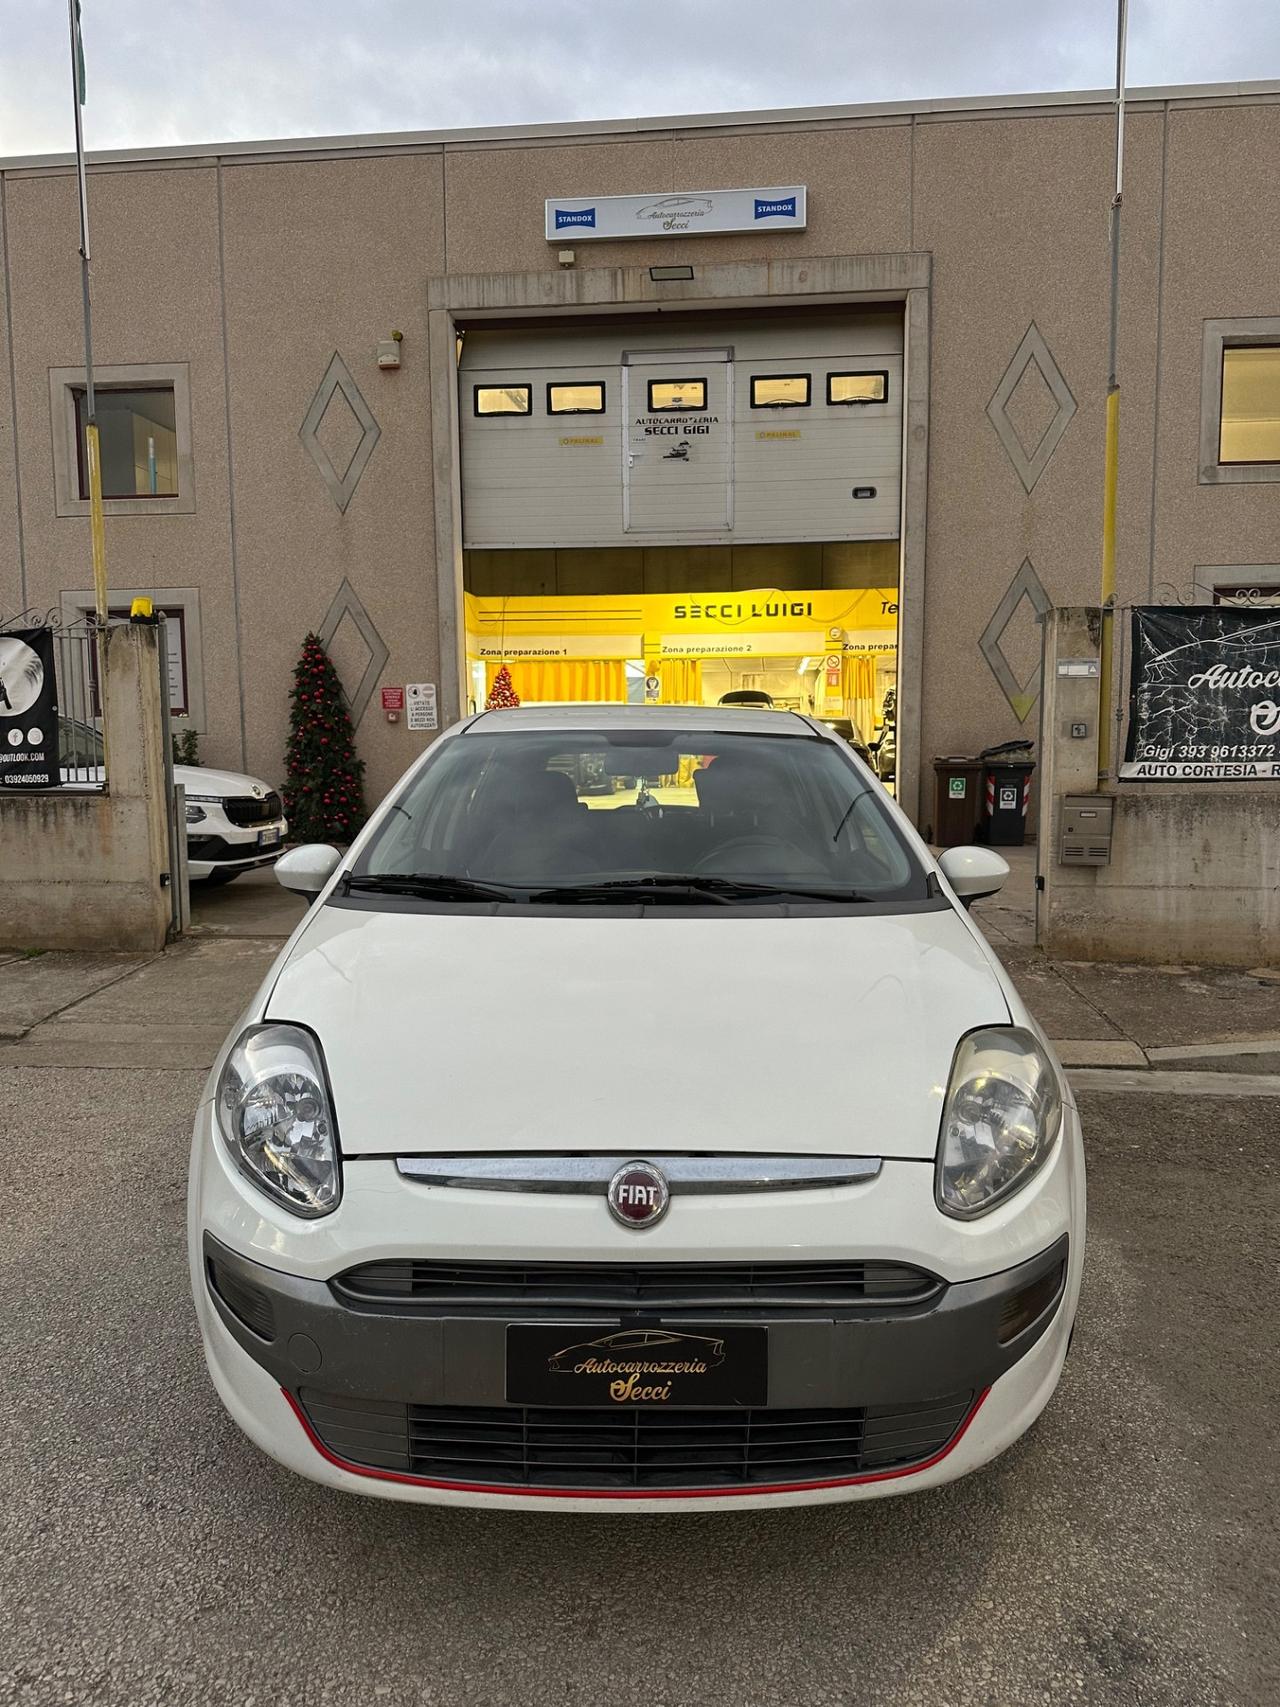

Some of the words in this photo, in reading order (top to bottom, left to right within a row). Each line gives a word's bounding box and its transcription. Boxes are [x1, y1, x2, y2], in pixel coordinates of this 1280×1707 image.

[757, 204, 793, 213] STANDOX
[558, 215, 592, 223] STANDOX
[648, 211, 704, 220] Autocarrozzeria
[662, 218, 690, 231] Secci
[644, 426, 678, 436] SECCI
[683, 425, 709, 435] GIGI
[674, 605, 742, 619] SECCI
[751, 602, 813, 618] LUIGI
[480, 648, 502, 656] Zona
[504, 648, 560, 657] preparazione
[562, 648, 567, 656] 1
[662, 646, 684, 654] Zona
[686, 645, 744, 655] preparazione
[746, 644, 752, 652] 2
[843, 643, 866, 651] Zona
[1143, 745, 1176, 760] Gigi
[1178, 745, 1206, 758] 393
[1210, 744, 1276, 758] 9613372
[1136, 764, 1178, 777] AUTO
[1182, 764, 1258, 777] CORTESIA
[618, 1184, 658, 1206] FIAT
[574, 1358, 708, 1374] Autocarrozzeria
[609, 1373, 673, 1402] Secci
